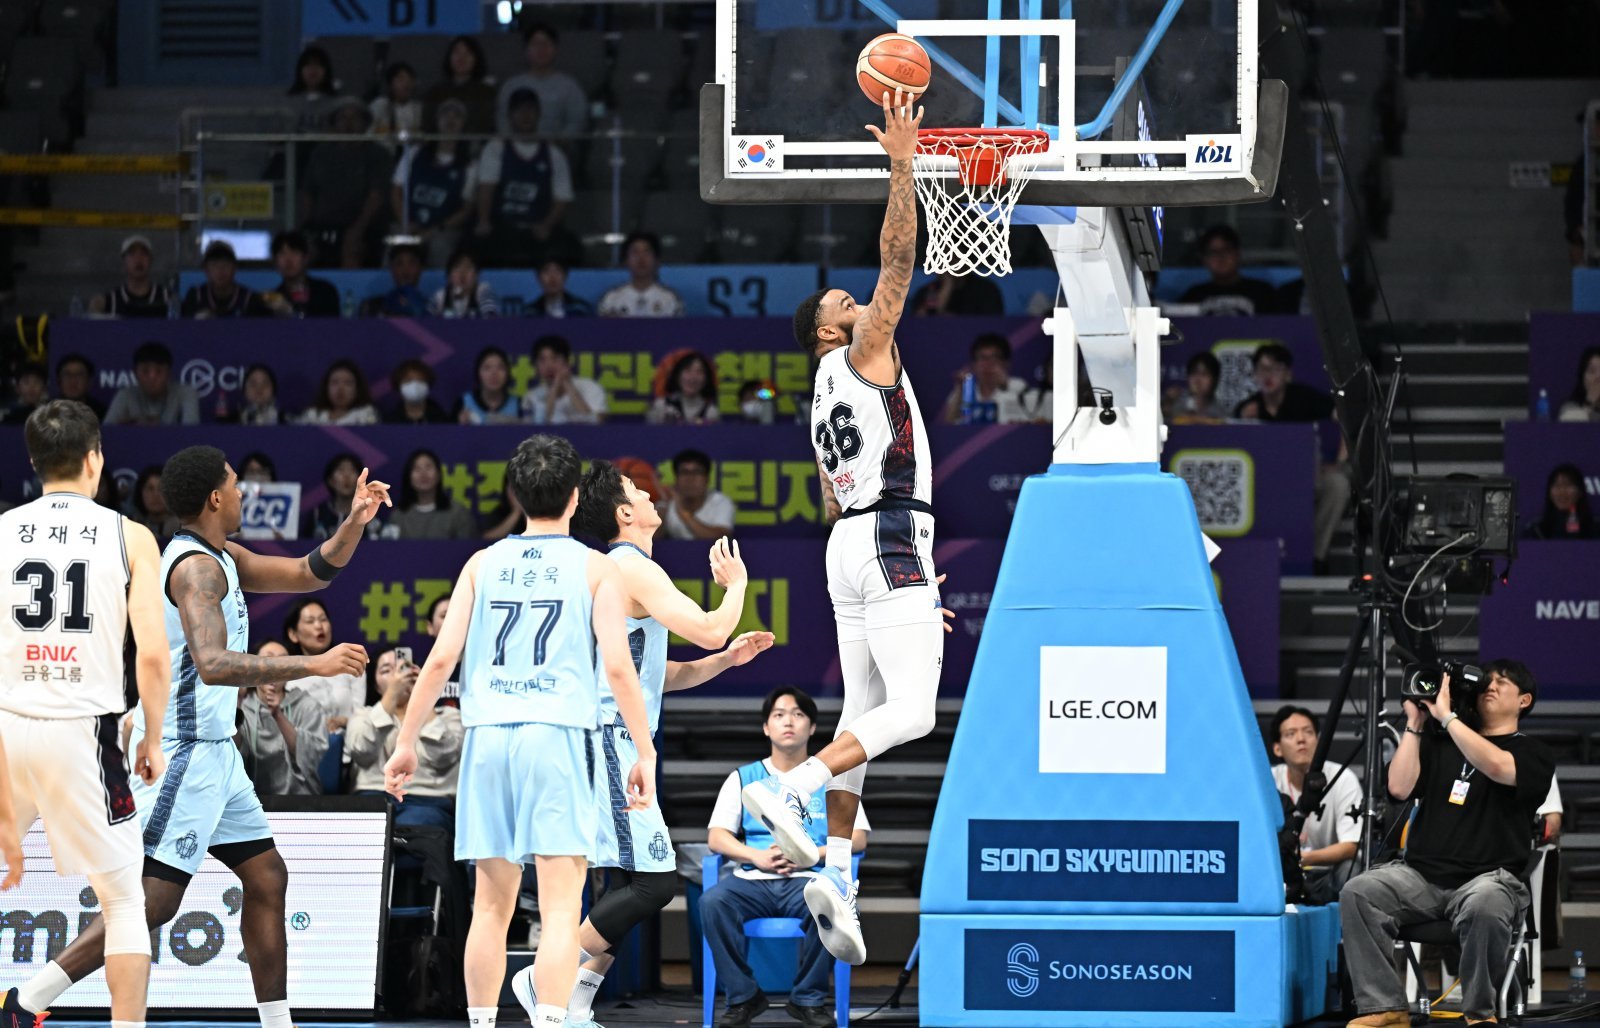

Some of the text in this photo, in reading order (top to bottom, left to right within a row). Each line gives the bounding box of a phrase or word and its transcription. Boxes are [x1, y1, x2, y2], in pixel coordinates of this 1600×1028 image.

[1195, 140, 1232, 164] KBL
[815, 401, 864, 475] 36
[12, 558, 94, 633] 31
[490, 599, 564, 667] 77
[26, 644, 78, 663] BNK
[21, 664, 84, 683] 금융그룹
[1048, 699, 1157, 720] LGE.COM
